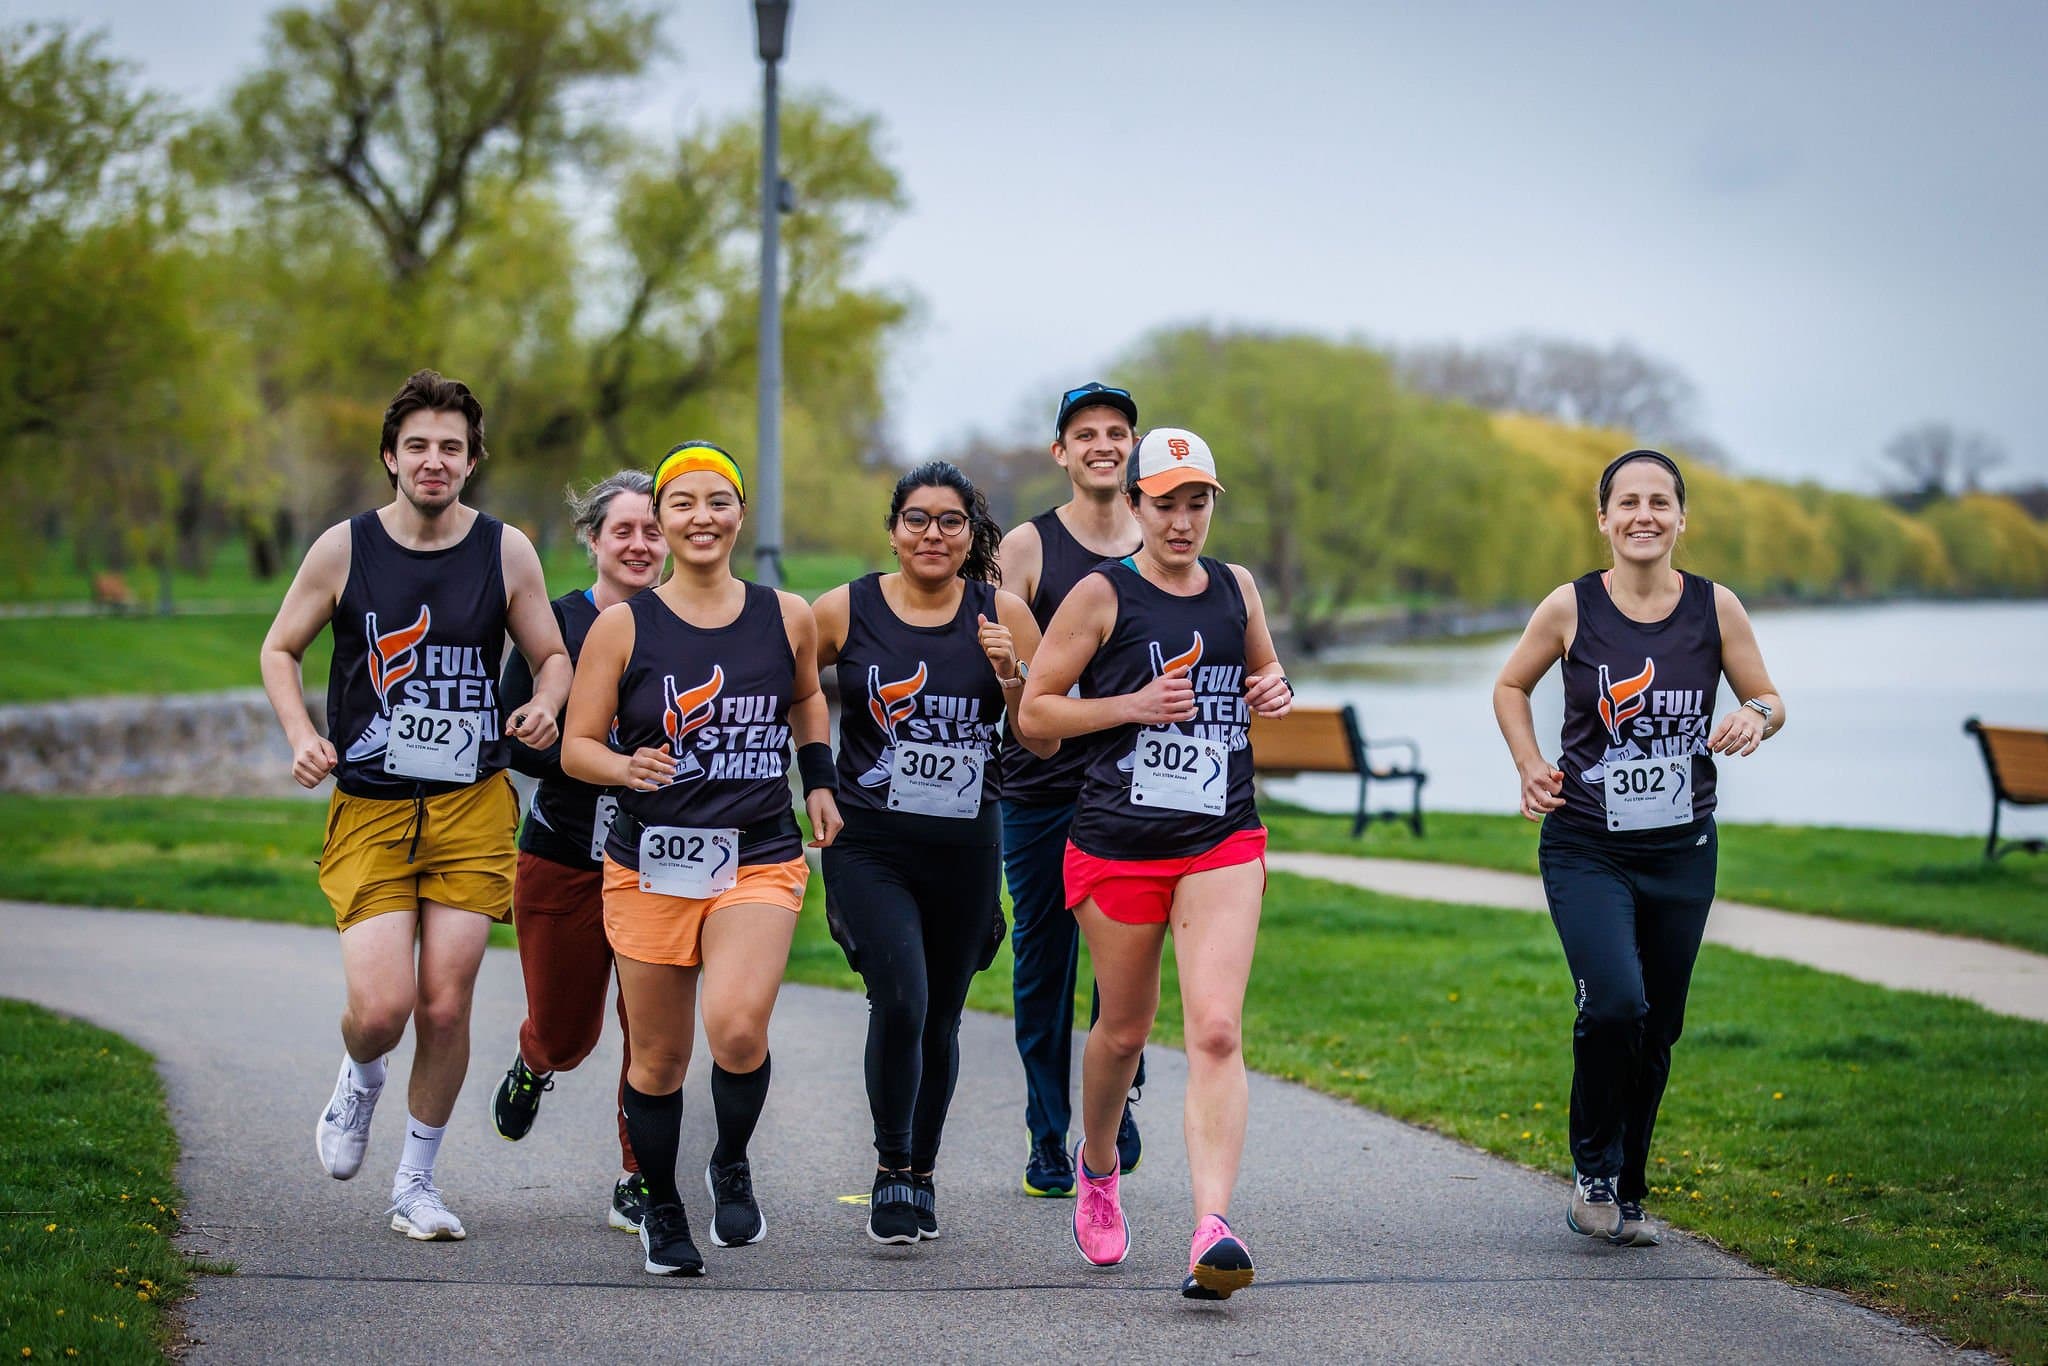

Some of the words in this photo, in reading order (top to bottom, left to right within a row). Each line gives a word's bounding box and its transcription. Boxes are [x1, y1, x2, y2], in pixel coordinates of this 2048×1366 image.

[1168, 438, 1190, 460] SF
[1195, 666, 1242, 693] FULL
[720, 695, 777, 724] FULL
[924, 695, 980, 722] FULL
[1194, 695, 1251, 724] TEM
[1652, 690, 1703, 716] FULL
[398, 714, 452, 745] 302
[696, 725, 789, 750] STEM
[707, 751, 783, 780] AHEAD
[901, 750, 956, 782] 302
[1143, 740, 1199, 774] 302
[1613, 766, 1666, 795] 302
[648, 834, 705, 863] 302
